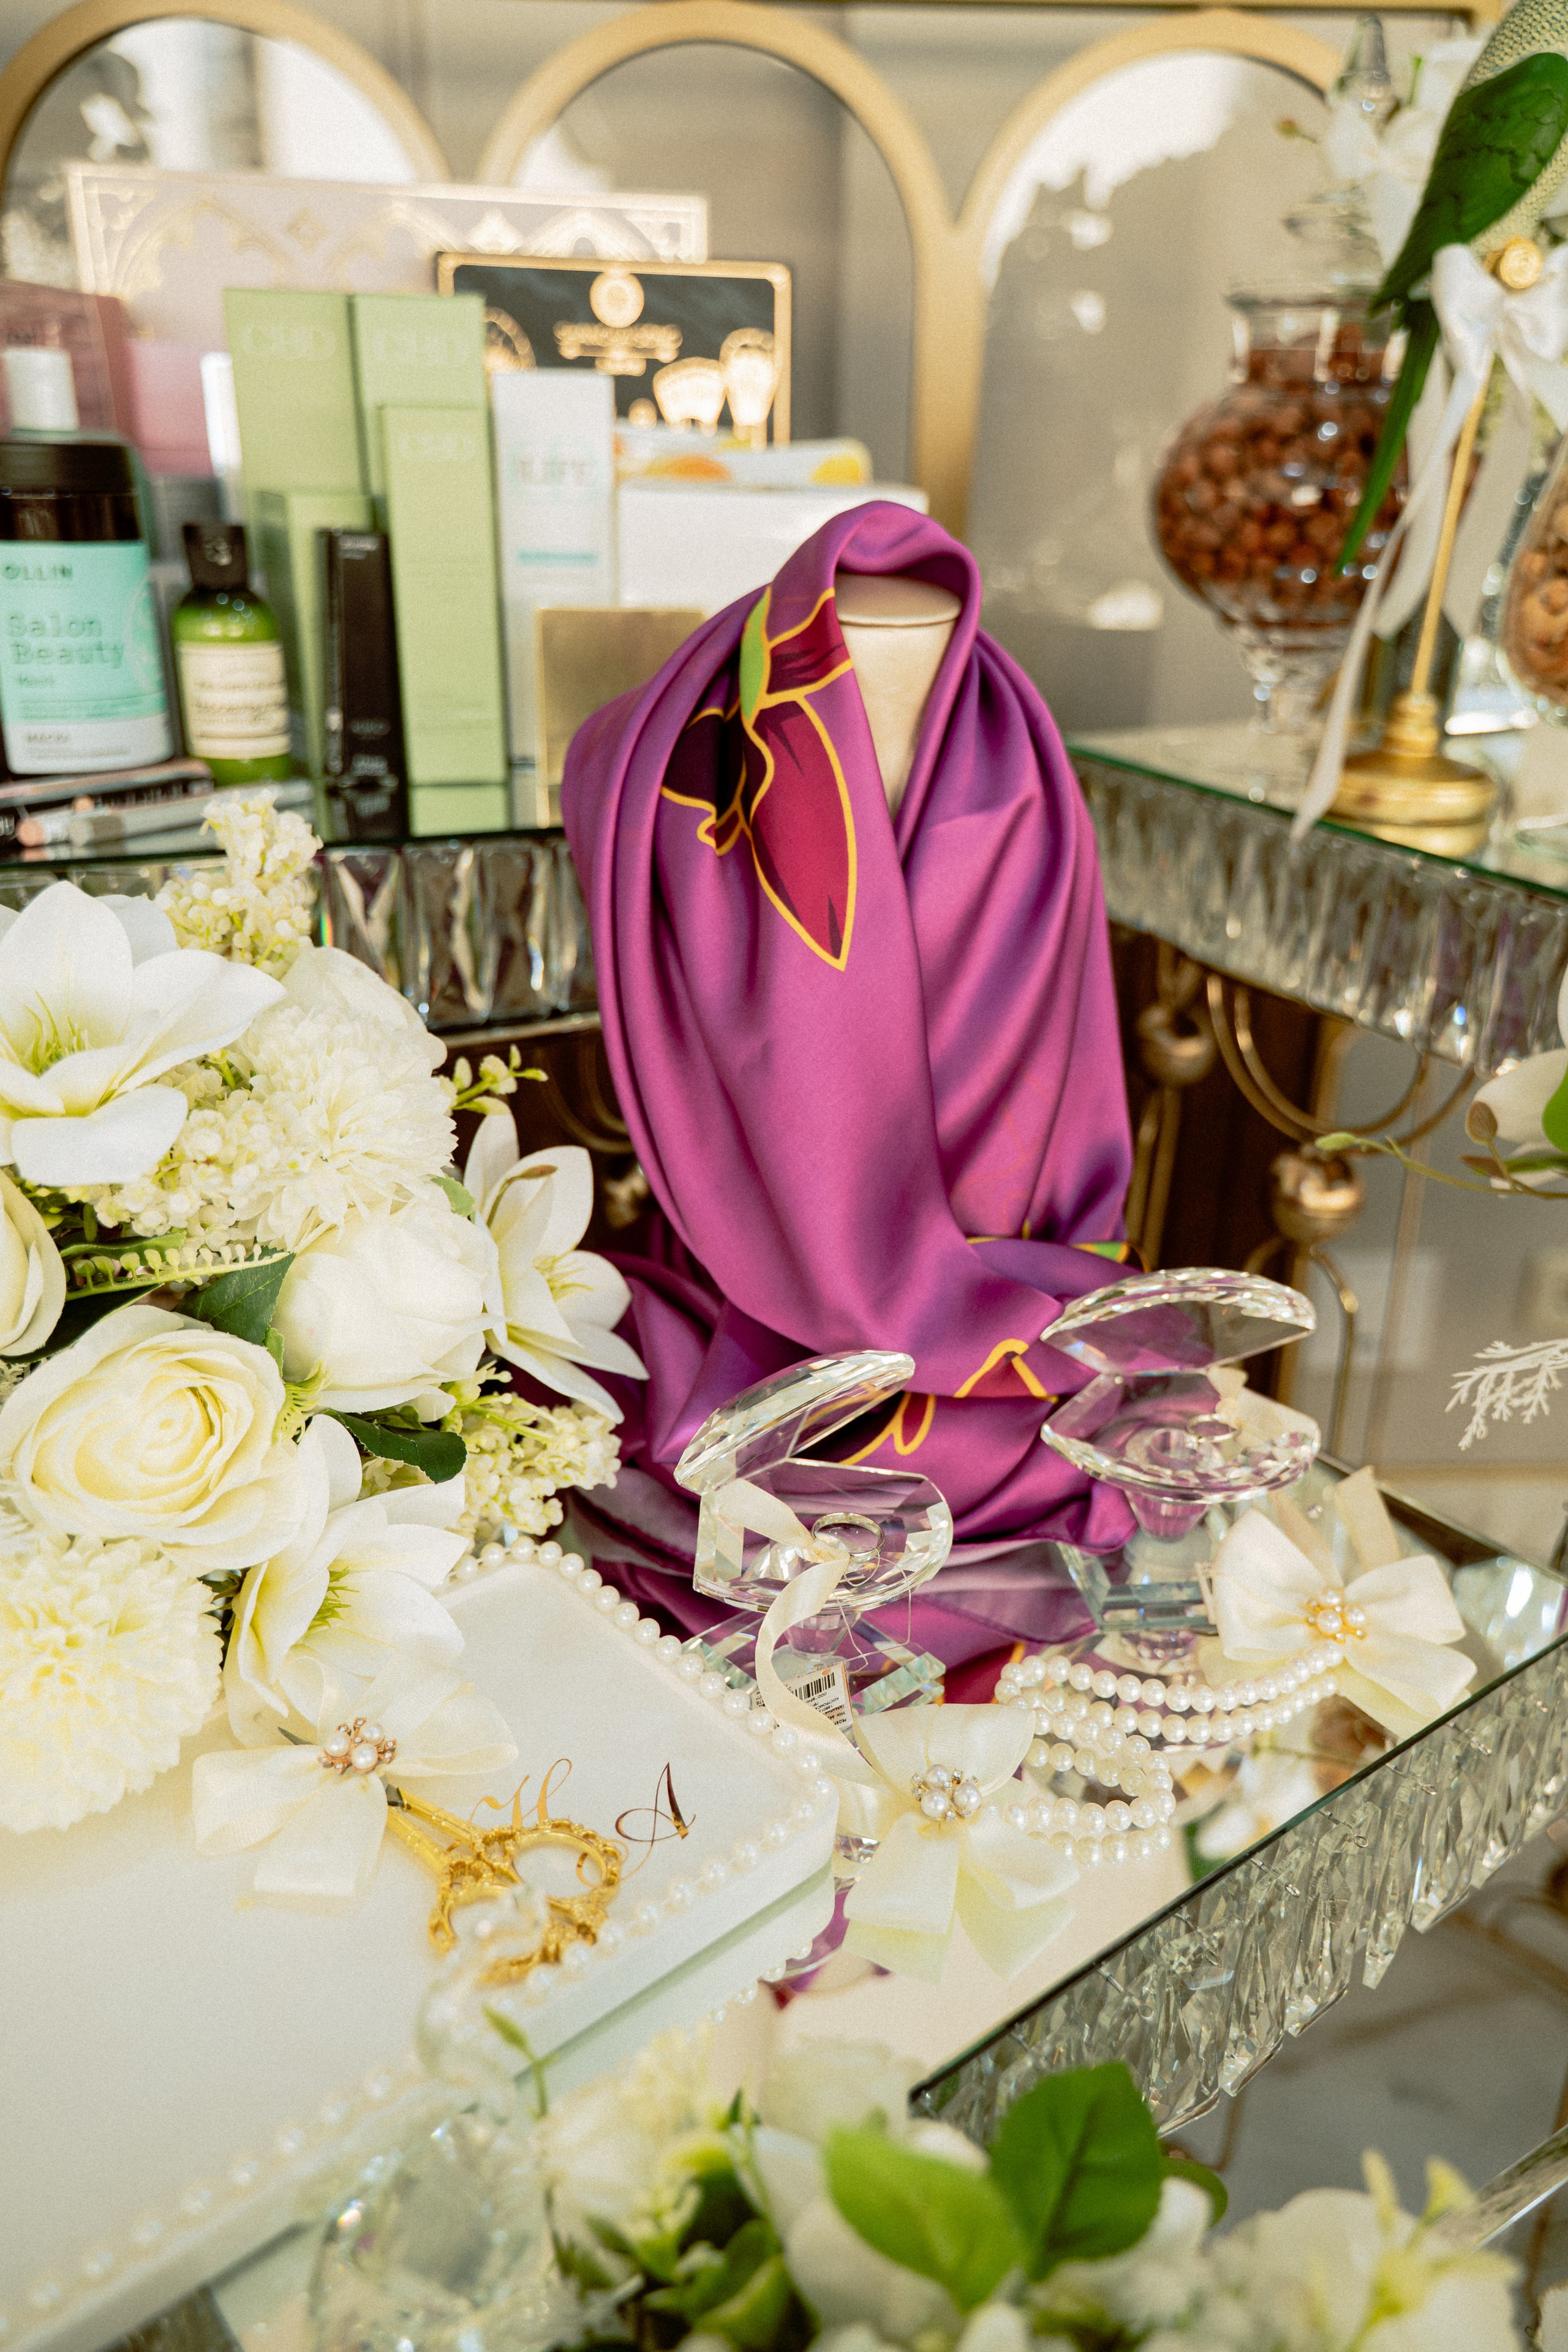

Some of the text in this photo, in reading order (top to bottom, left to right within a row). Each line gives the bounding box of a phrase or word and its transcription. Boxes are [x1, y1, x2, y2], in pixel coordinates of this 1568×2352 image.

[2, 562, 74, 581] OLLIN
[7, 611, 102, 638] Salon
[10, 641, 124, 669] Beauty
